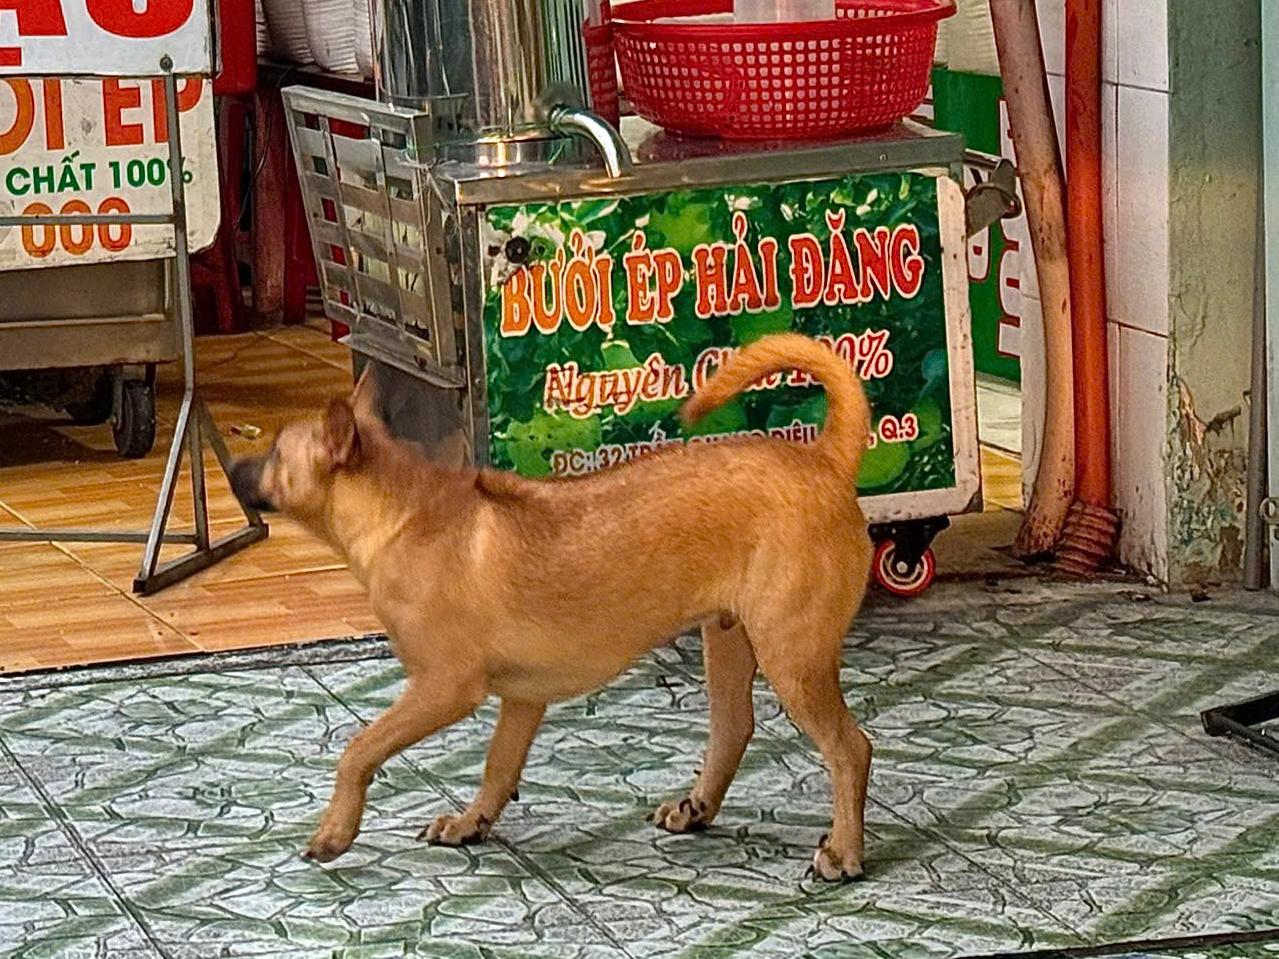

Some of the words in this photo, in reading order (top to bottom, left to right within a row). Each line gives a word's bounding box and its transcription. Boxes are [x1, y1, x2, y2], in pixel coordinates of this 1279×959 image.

[5, 150, 96, 197] CHẤT
[500, 228, 616, 339] BƯỞI
[625, 229, 684, 326] ÉP
[692, 212, 781, 319] HẢI
[788, 208, 925, 309] ĐĂNG
[543, 353, 689, 420] Nguyên
